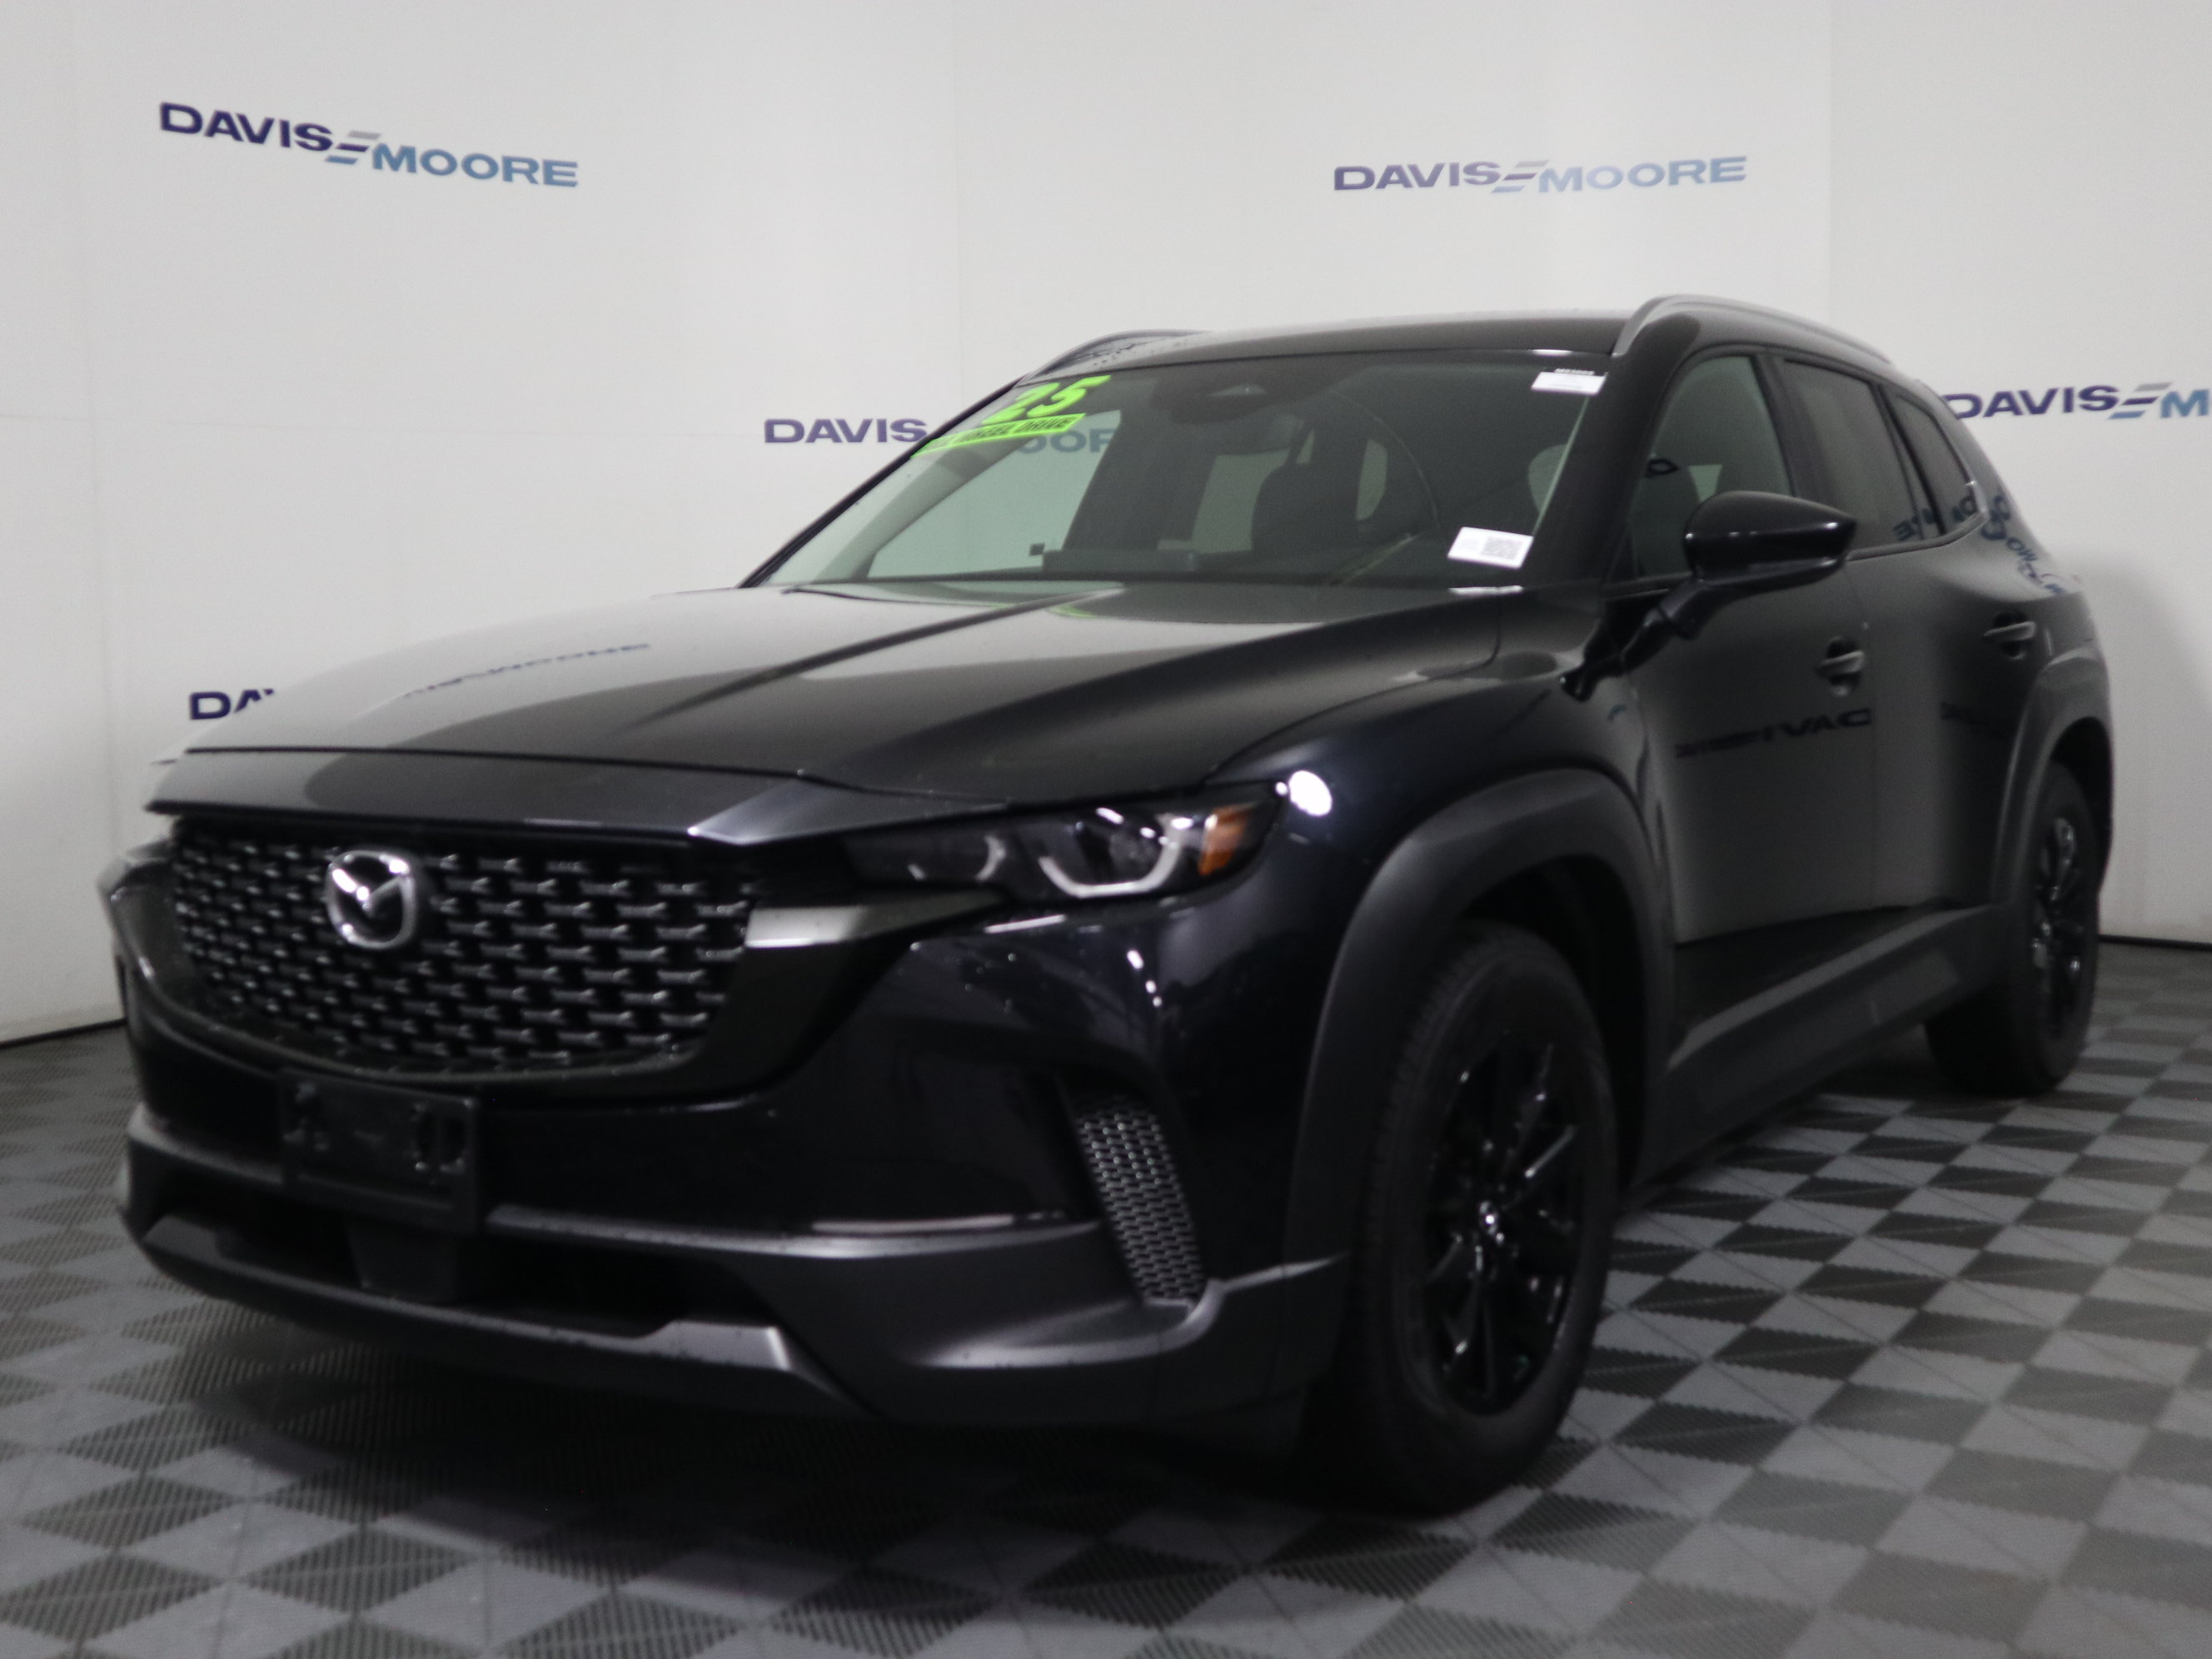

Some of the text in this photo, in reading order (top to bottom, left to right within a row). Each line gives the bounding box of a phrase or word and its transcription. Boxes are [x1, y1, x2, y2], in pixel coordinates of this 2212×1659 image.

[160, 102, 579, 187] DAVIS MOORE
[1333, 155, 1747, 193] DAVIS MOORE
[981, 375, 1111, 425] 25
[1940, 385, 2119, 421] DAVIS
[764, 418, 928, 444] DAVIS
